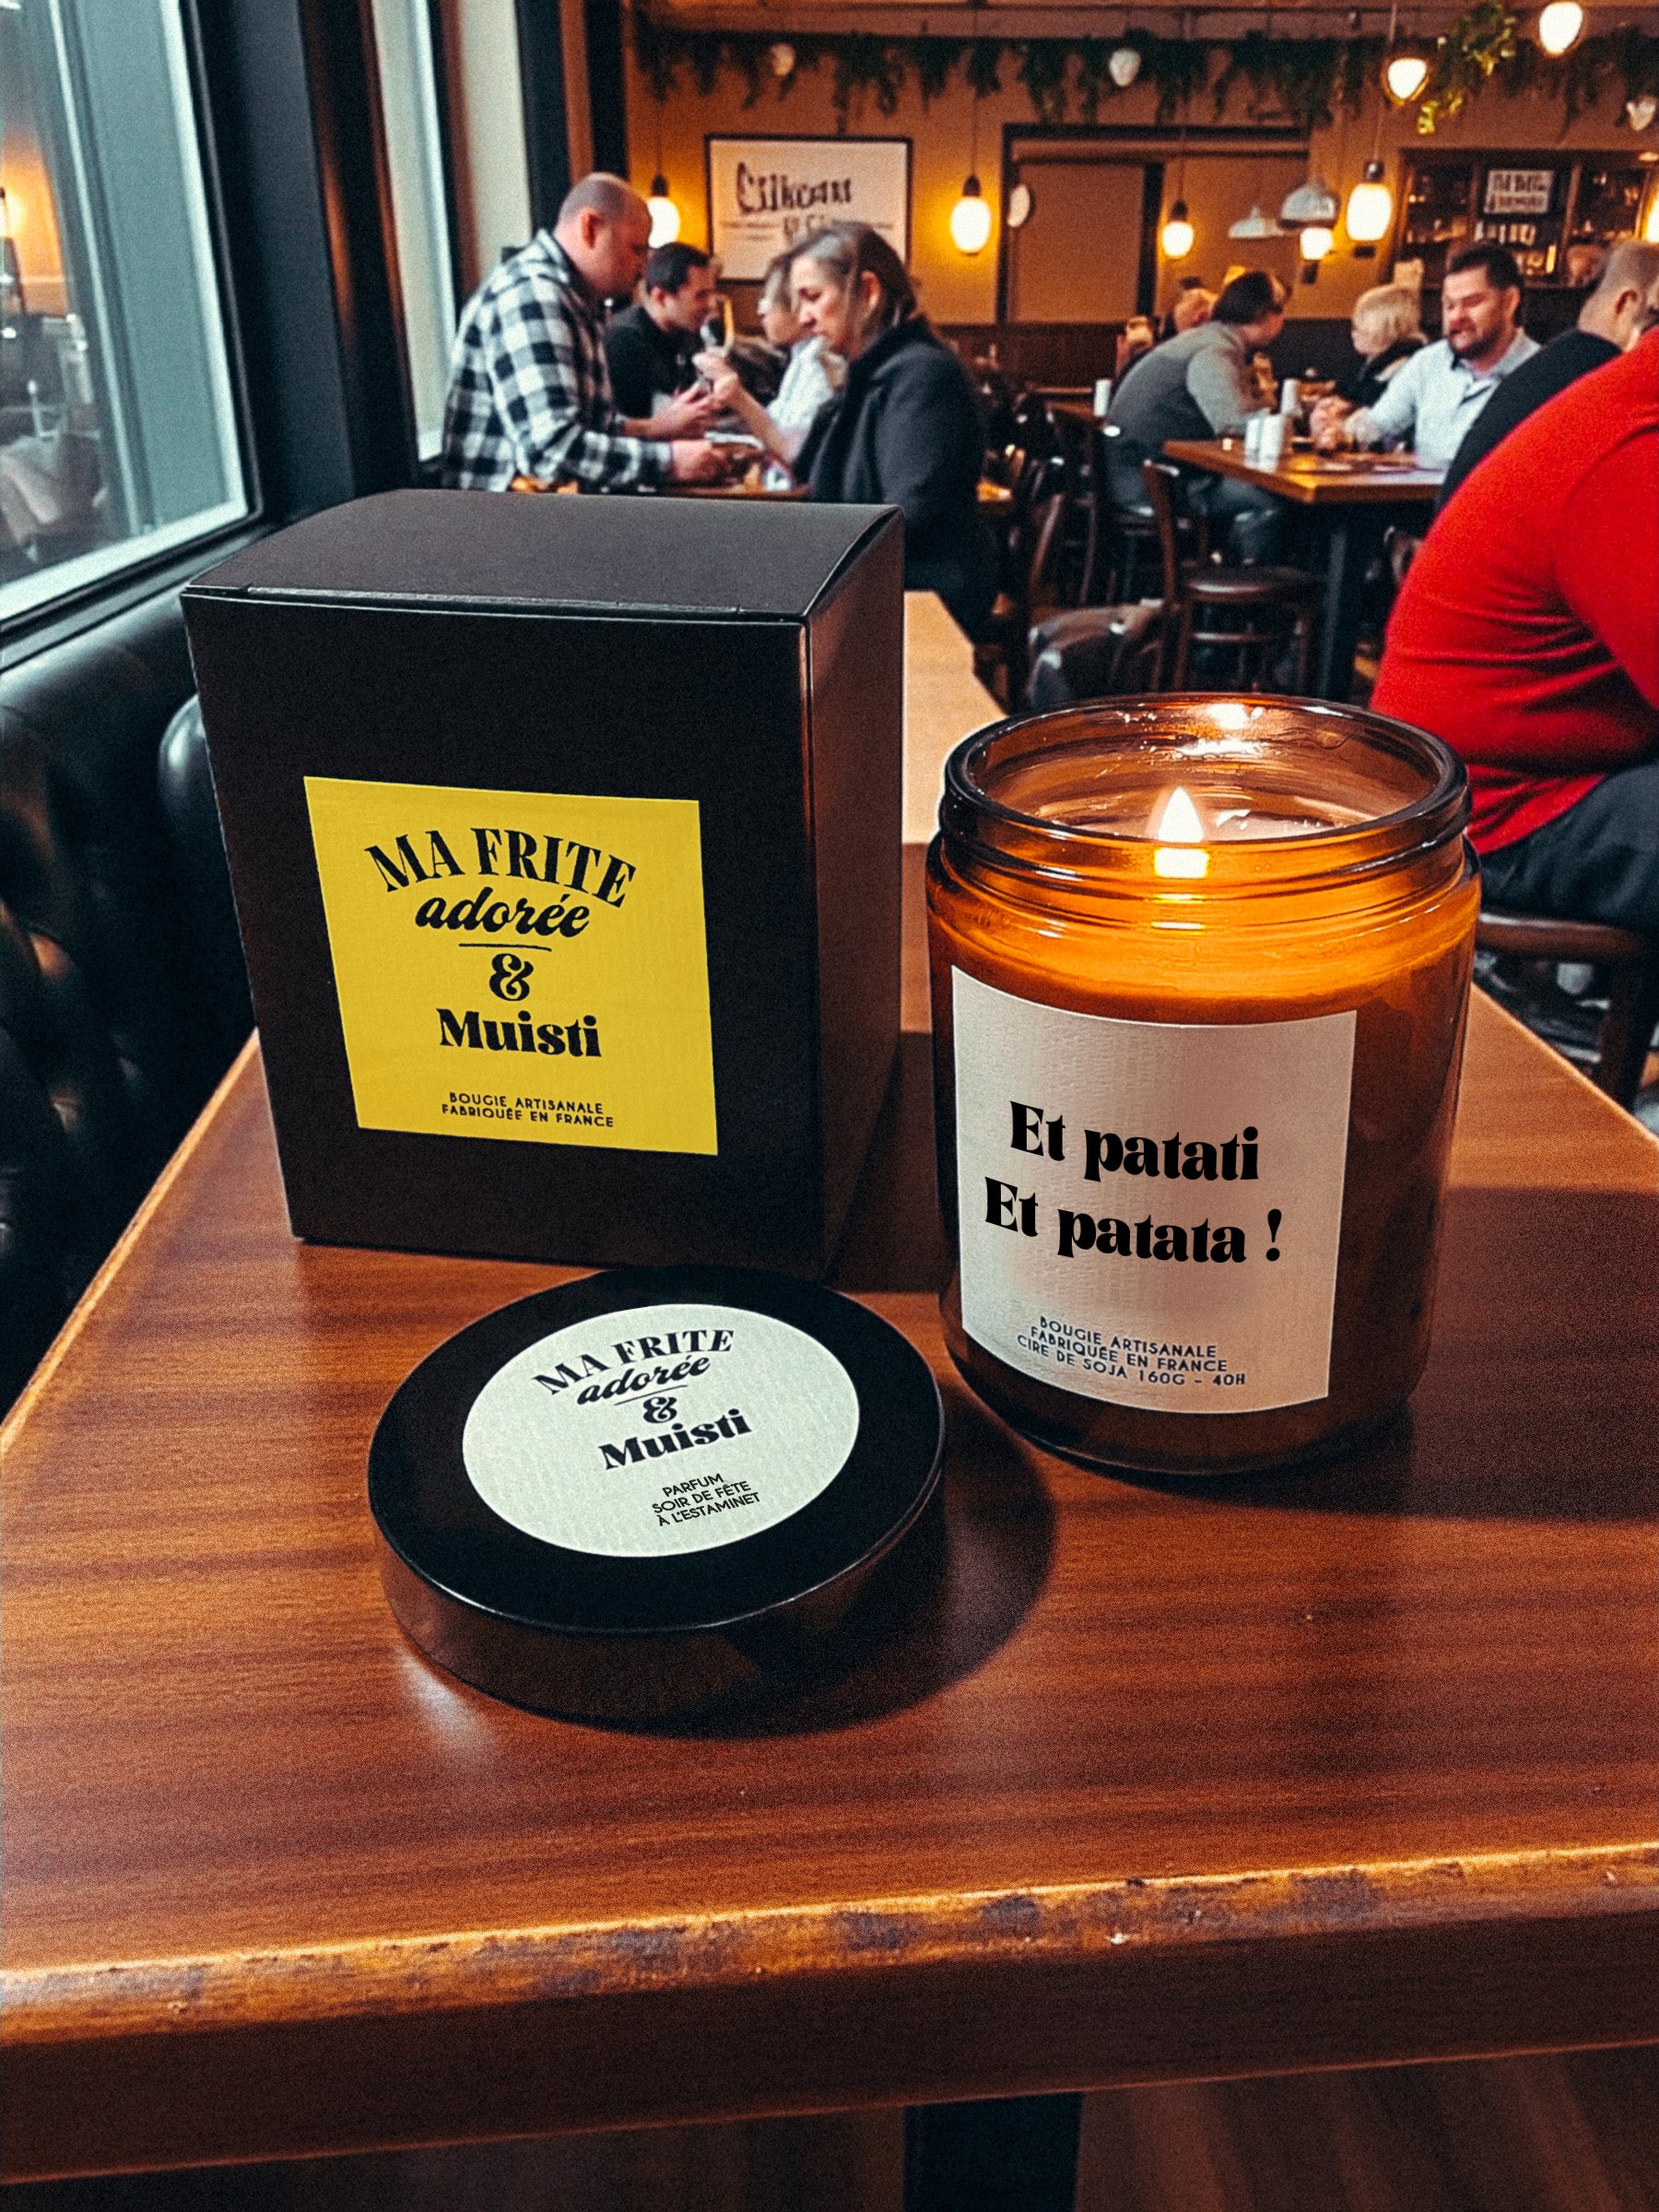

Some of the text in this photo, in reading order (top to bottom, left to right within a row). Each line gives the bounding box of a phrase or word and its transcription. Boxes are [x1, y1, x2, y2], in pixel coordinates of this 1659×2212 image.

[364, 827, 637, 909] MA FRITE
[415, 886, 590, 938] adorée
[488, 953, 535, 1002] &
[436, 1007, 602, 1058] Muisti
[449, 1091, 605, 1115] BOUGIE ARTISANALE
[530, 1112, 549, 1123] EN
[556, 1112, 615, 1128] FRANCE
[1010, 1100, 1259, 1182] Et patati
[984, 1176, 1283, 1264] Et patata !
[531, 1329, 735, 1395] MA FRITE
[1017, 1335, 1049, 1358] CIRE
[1056, 1349, 1076, 1366] DE
[1082, 1358, 1128, 1379] SOJA
[1138, 1370, 1185, 1386] 160G
[1212, 1372, 1246, 1386] 40H
[1030, 1325, 1228, 1372] FABRIQUÉE EN FRANCE
[1040, 1315, 1217, 1359] BOUGIE ARTISANALE
[576, 1355, 711, 1406] adorée
[642, 1396, 677, 1424] &
[598, 1407, 752, 1470] Muisti
[652, 1480, 752, 1513] SOIR DE FÊTE
[655, 1491, 760, 1527] À L'ESTAMINET
[662, 1473, 724, 1498] PARFUM
